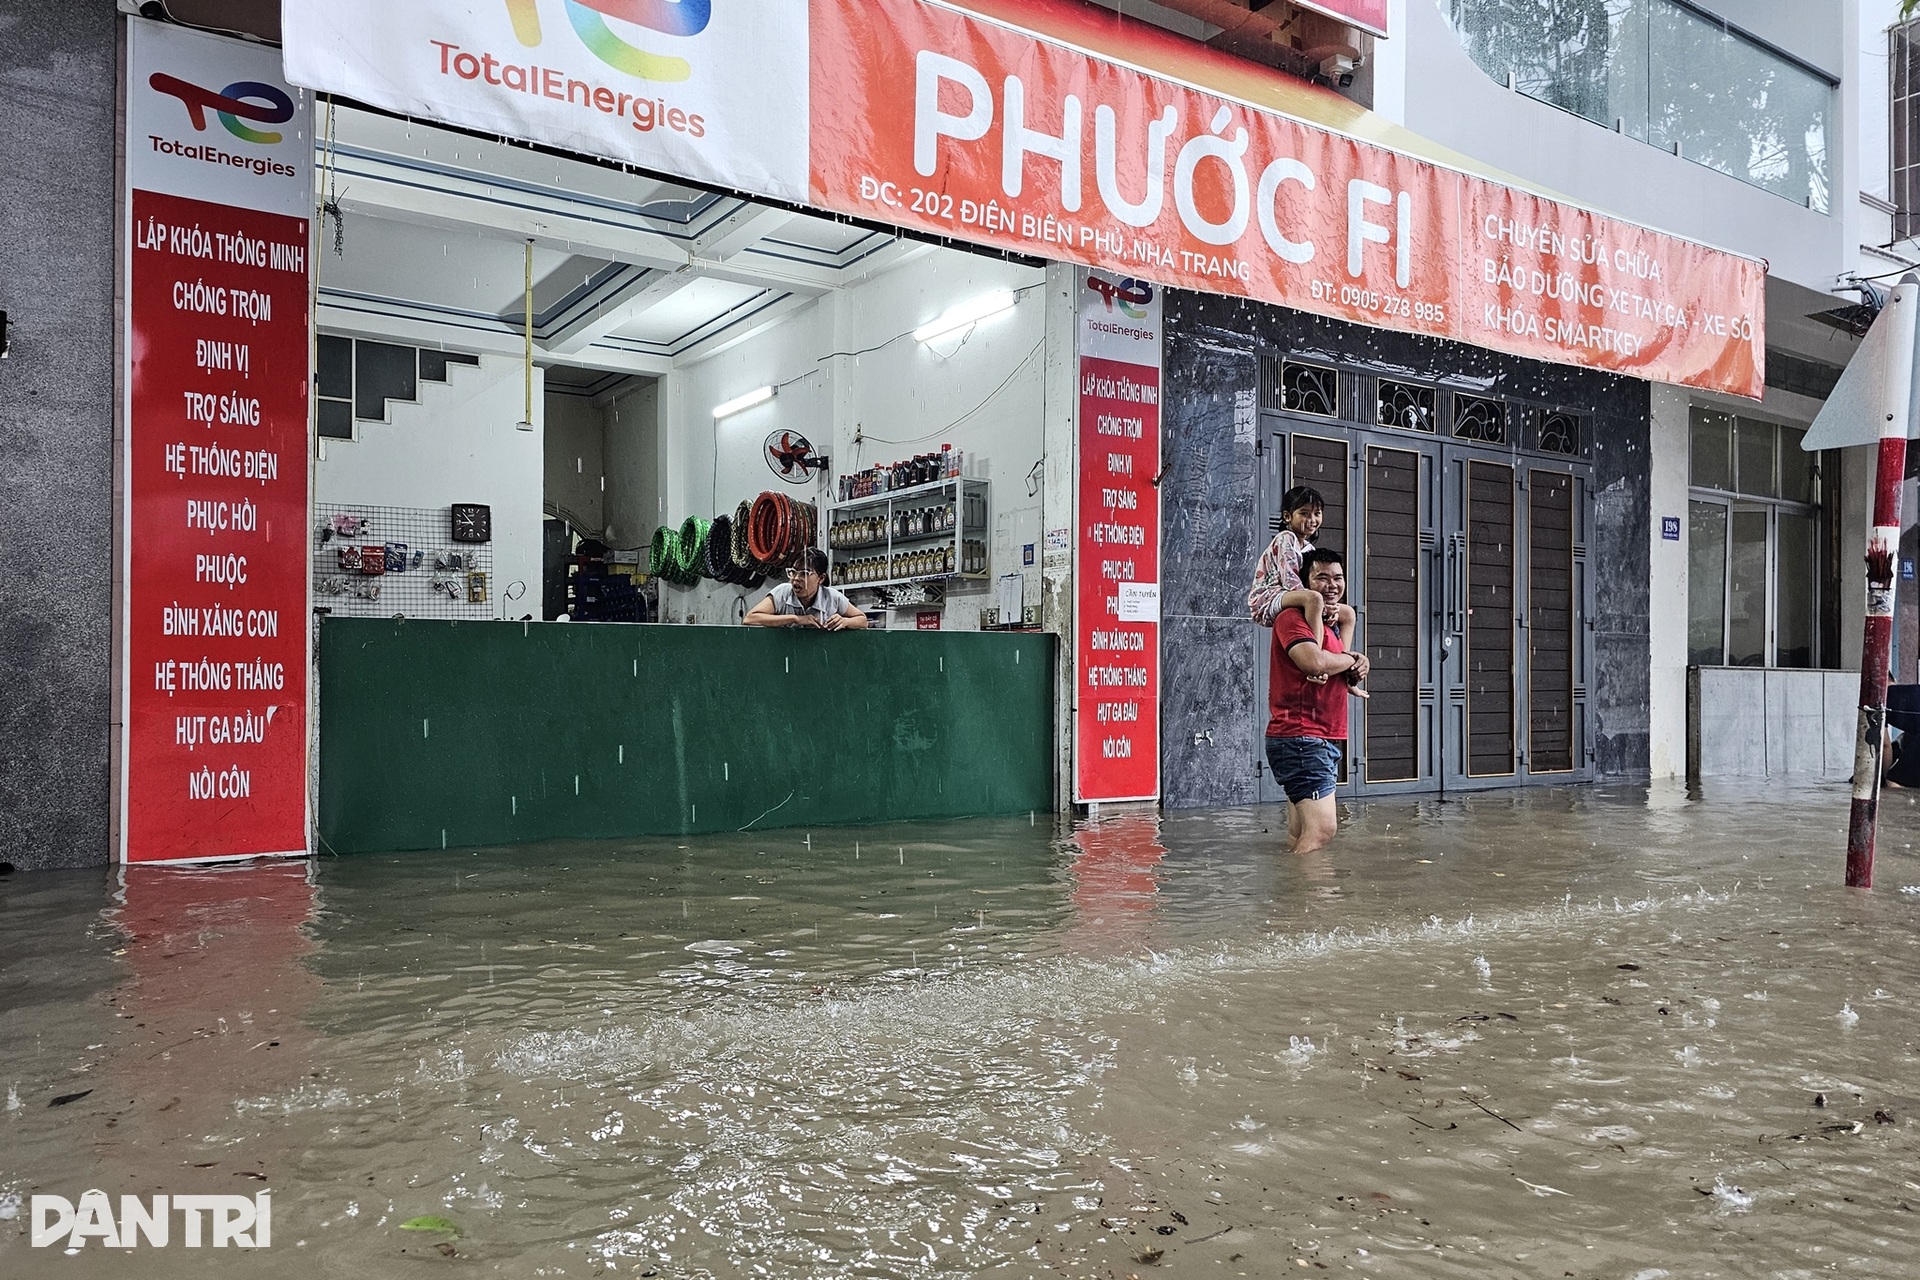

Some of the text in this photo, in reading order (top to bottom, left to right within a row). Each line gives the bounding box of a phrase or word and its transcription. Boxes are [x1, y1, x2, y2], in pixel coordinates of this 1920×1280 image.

[430, 39, 705, 138] TotalEnergies
[148, 134, 296, 179] TotalEnergies
[913, 49, 1411, 289] PHƯỚC FI
[137, 216, 304, 274] LẮP KHÓA THÔNG MINH
[860, 175, 1250, 281] ĐC: 202 ĐIỆN BIÊN PHỦ, NHA TRANG
[1484, 214, 1661, 284] CHUYÊN SỬA CHỮA
[173, 278, 271, 326] CHỐNG TRỘM
[1311, 280, 1445, 323] ĐT: 0905 278 985
[1484, 255, 1526, 290] BẢO
[1531, 271, 1604, 308] DƯỠNG
[1609, 287, 1629, 315] XE
[1632, 293, 1663, 322] TAY
[1665, 304, 1687, 331] GA
[1703, 312, 1726, 336] XE
[1731, 313, 1753, 341] SỐ
[1087, 318, 1154, 341] TotalEnergies
[1484, 301, 1643, 358] KHÓA SMARTKEY
[196, 339, 249, 379] ĐỊNH VỊ
[184, 390, 260, 428] TRỢ SÁNG
[1096, 375, 1116, 399] KHÓA
[1117, 379, 1140, 403] THÔNG
[1141, 385, 1157, 405] MINH
[1123, 417, 1142, 443] TRỘM
[165, 442, 277, 485] HỆ THỐNG ĐIỆN
[1107, 453, 1133, 479] ĐỊNH VỊ
[187, 497, 257, 536] PHỤC HỒI
[1102, 486, 1137, 511] TRỢ SÁNG
[1093, 521, 1103, 547] HỆ
[1129, 525, 1145, 550] ĐIỆN
[1665, 520, 1678, 533] 198
[196, 553, 248, 590] PHUỘC
[1102, 560, 1122, 583] PHỤC
[163, 601, 278, 638] BÌNH XĂNG CON
[1092, 626, 1108, 651] BÌNH
[1129, 632, 1144, 651] CON
[155, 656, 284, 697] HỆ THỐNG THẮNG
[1088, 664, 1099, 691] HỆ
[176, 709, 264, 751] HỤT GA ĐẦU
[1097, 702, 1112, 726] HỤT
[1112, 702, 1123, 722] GA
[1116, 735, 1131, 758] CÔN
[189, 764, 250, 800] NỒI CÔN
